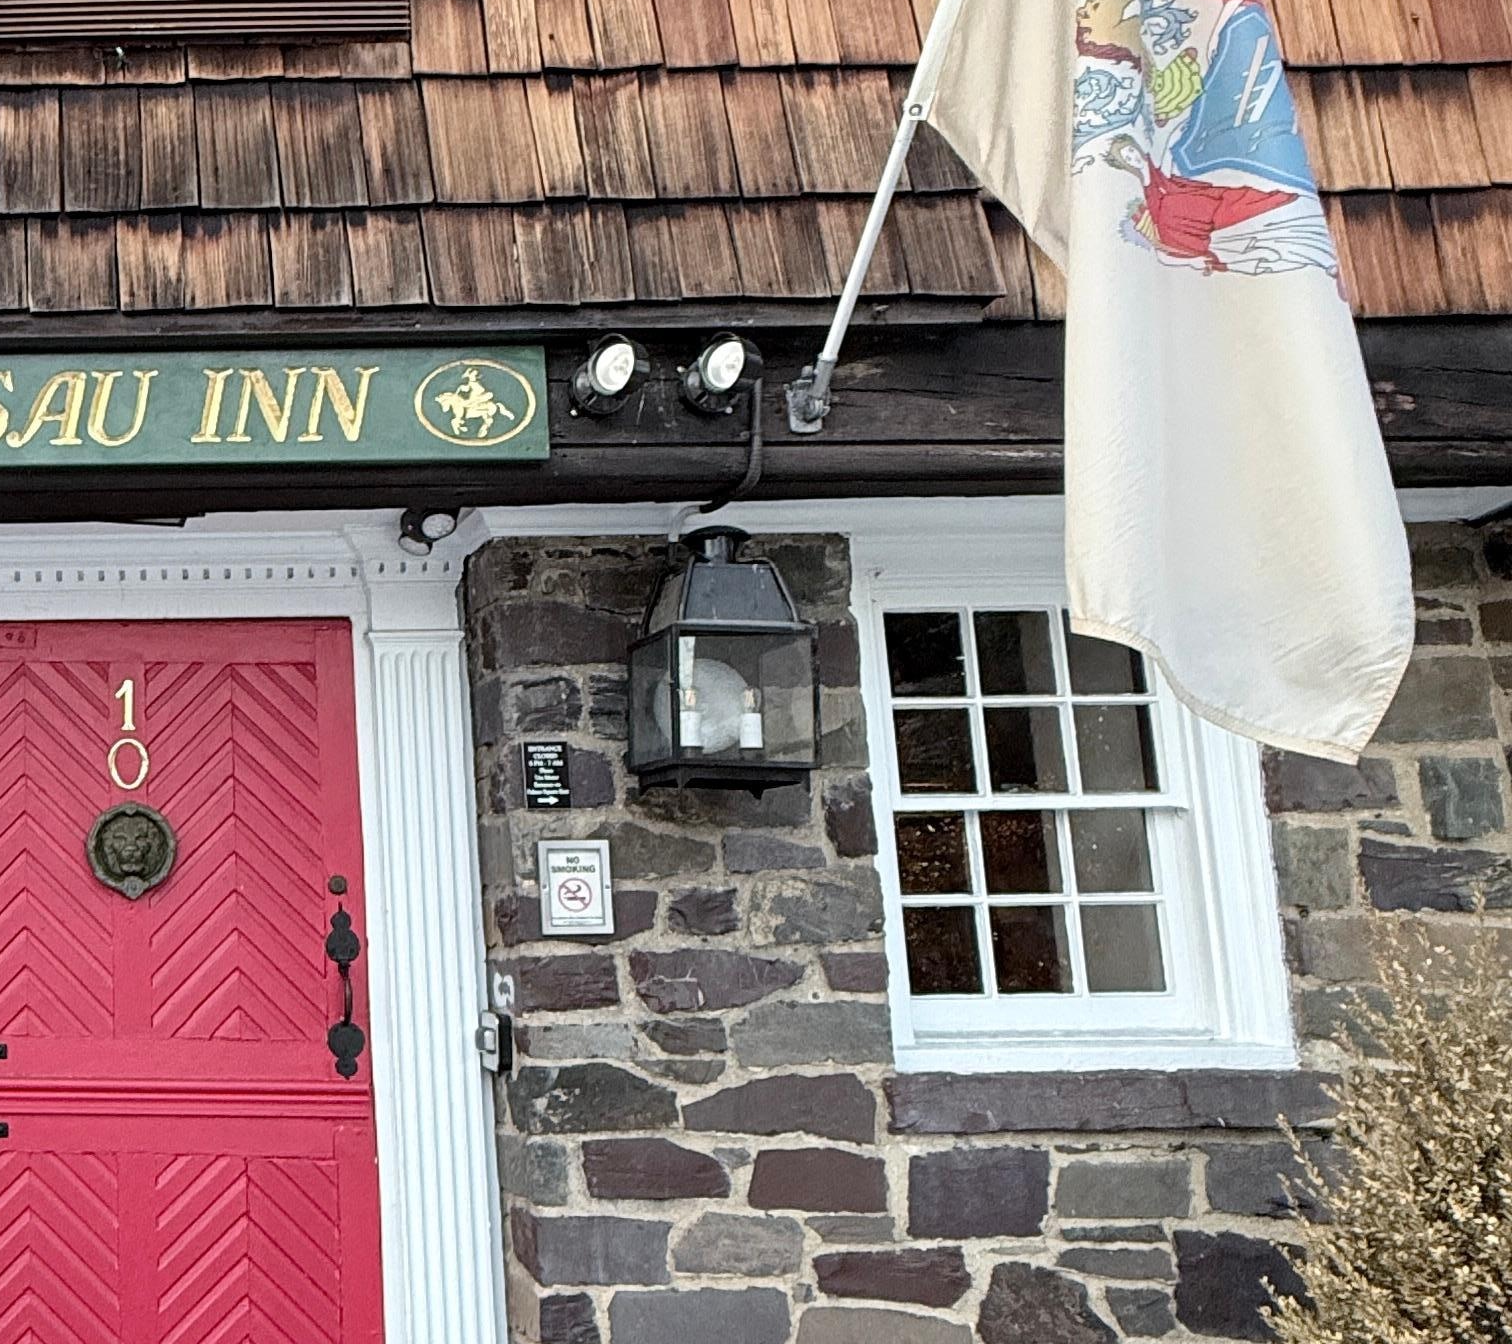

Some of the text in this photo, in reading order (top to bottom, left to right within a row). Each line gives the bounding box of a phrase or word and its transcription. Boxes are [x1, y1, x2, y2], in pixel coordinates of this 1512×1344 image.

[190, 366, 380, 443] INN
[566, 856, 580, 864] NO
[551, 865, 596, 873] SMOKING
